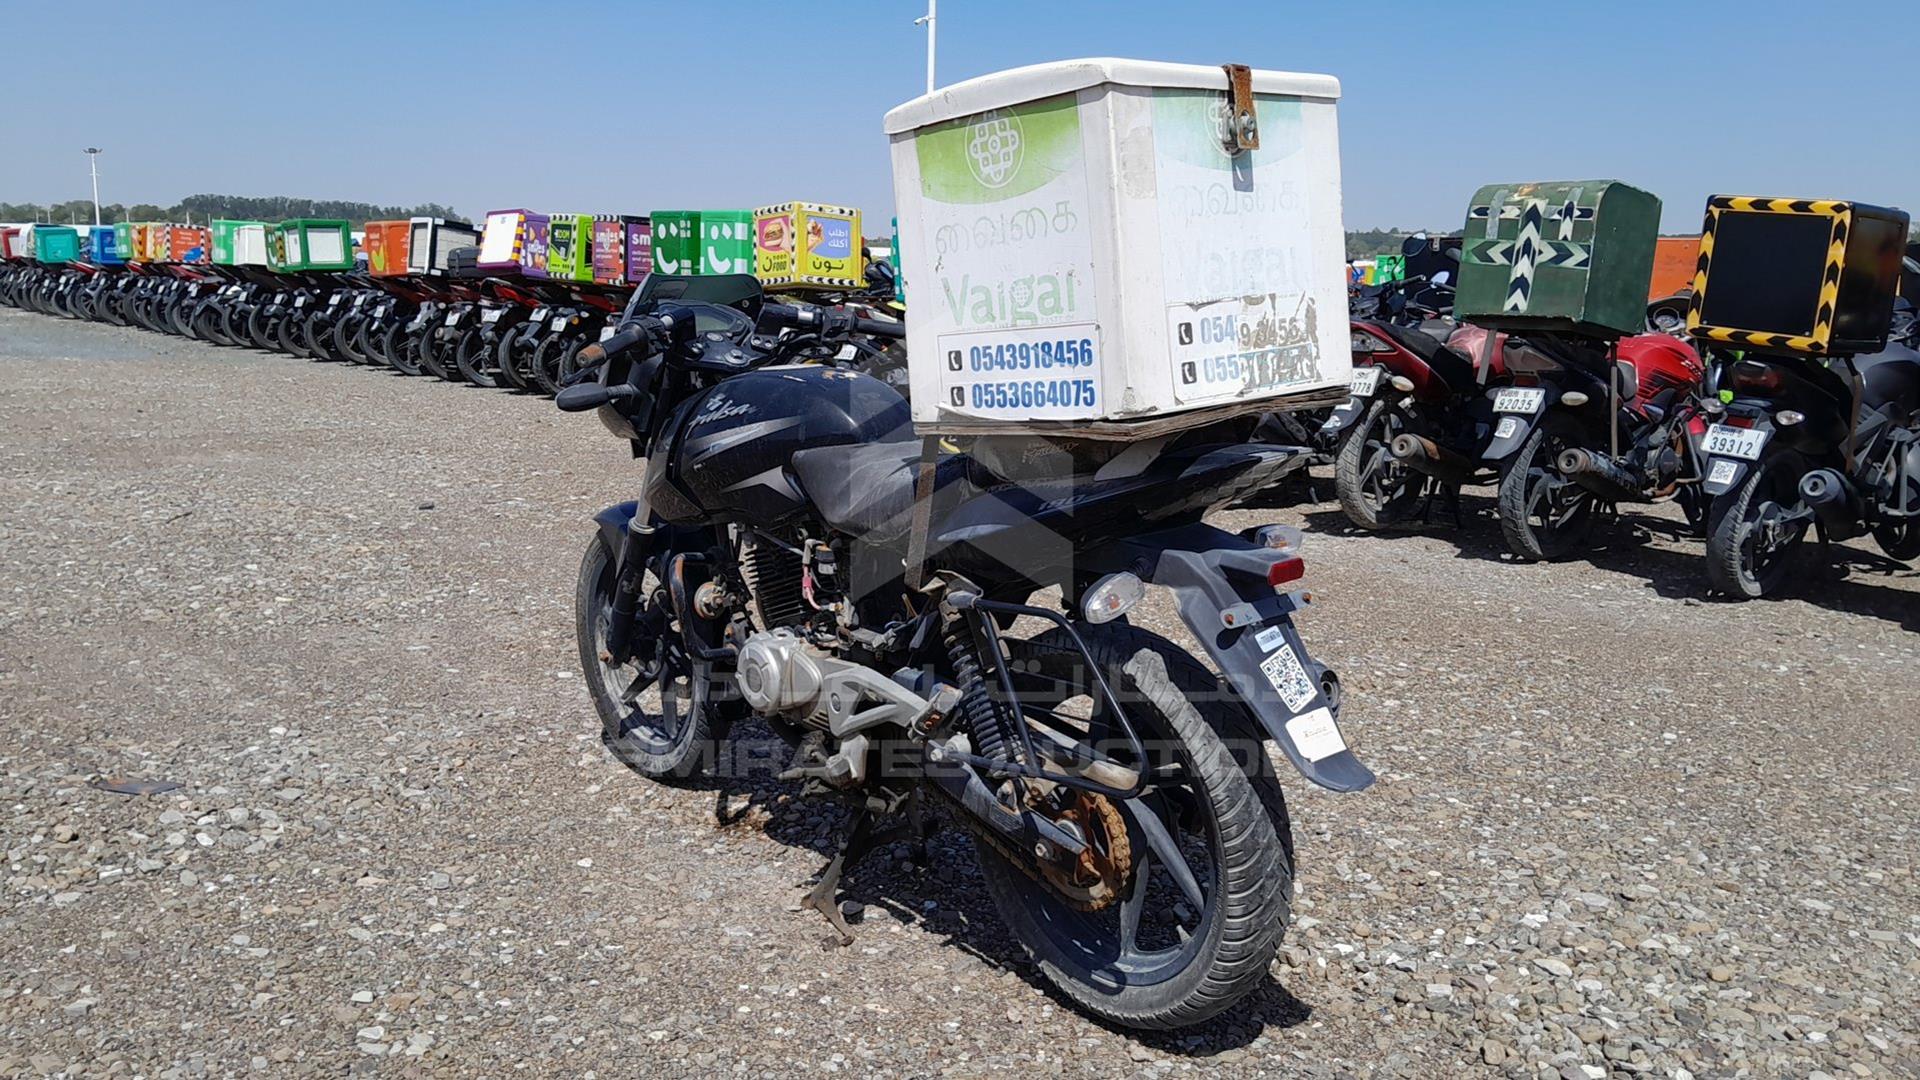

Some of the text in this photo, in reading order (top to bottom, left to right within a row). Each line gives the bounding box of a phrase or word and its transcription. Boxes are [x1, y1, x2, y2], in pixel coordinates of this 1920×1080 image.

[941, 269, 1075, 327] Vaigai
[970, 339, 1093, 372] 0543918456
[972, 379, 1096, 409] 0553664075
[1498, 398, 1532, 411] 92035
[1709, 436, 1754, 456] 39312
